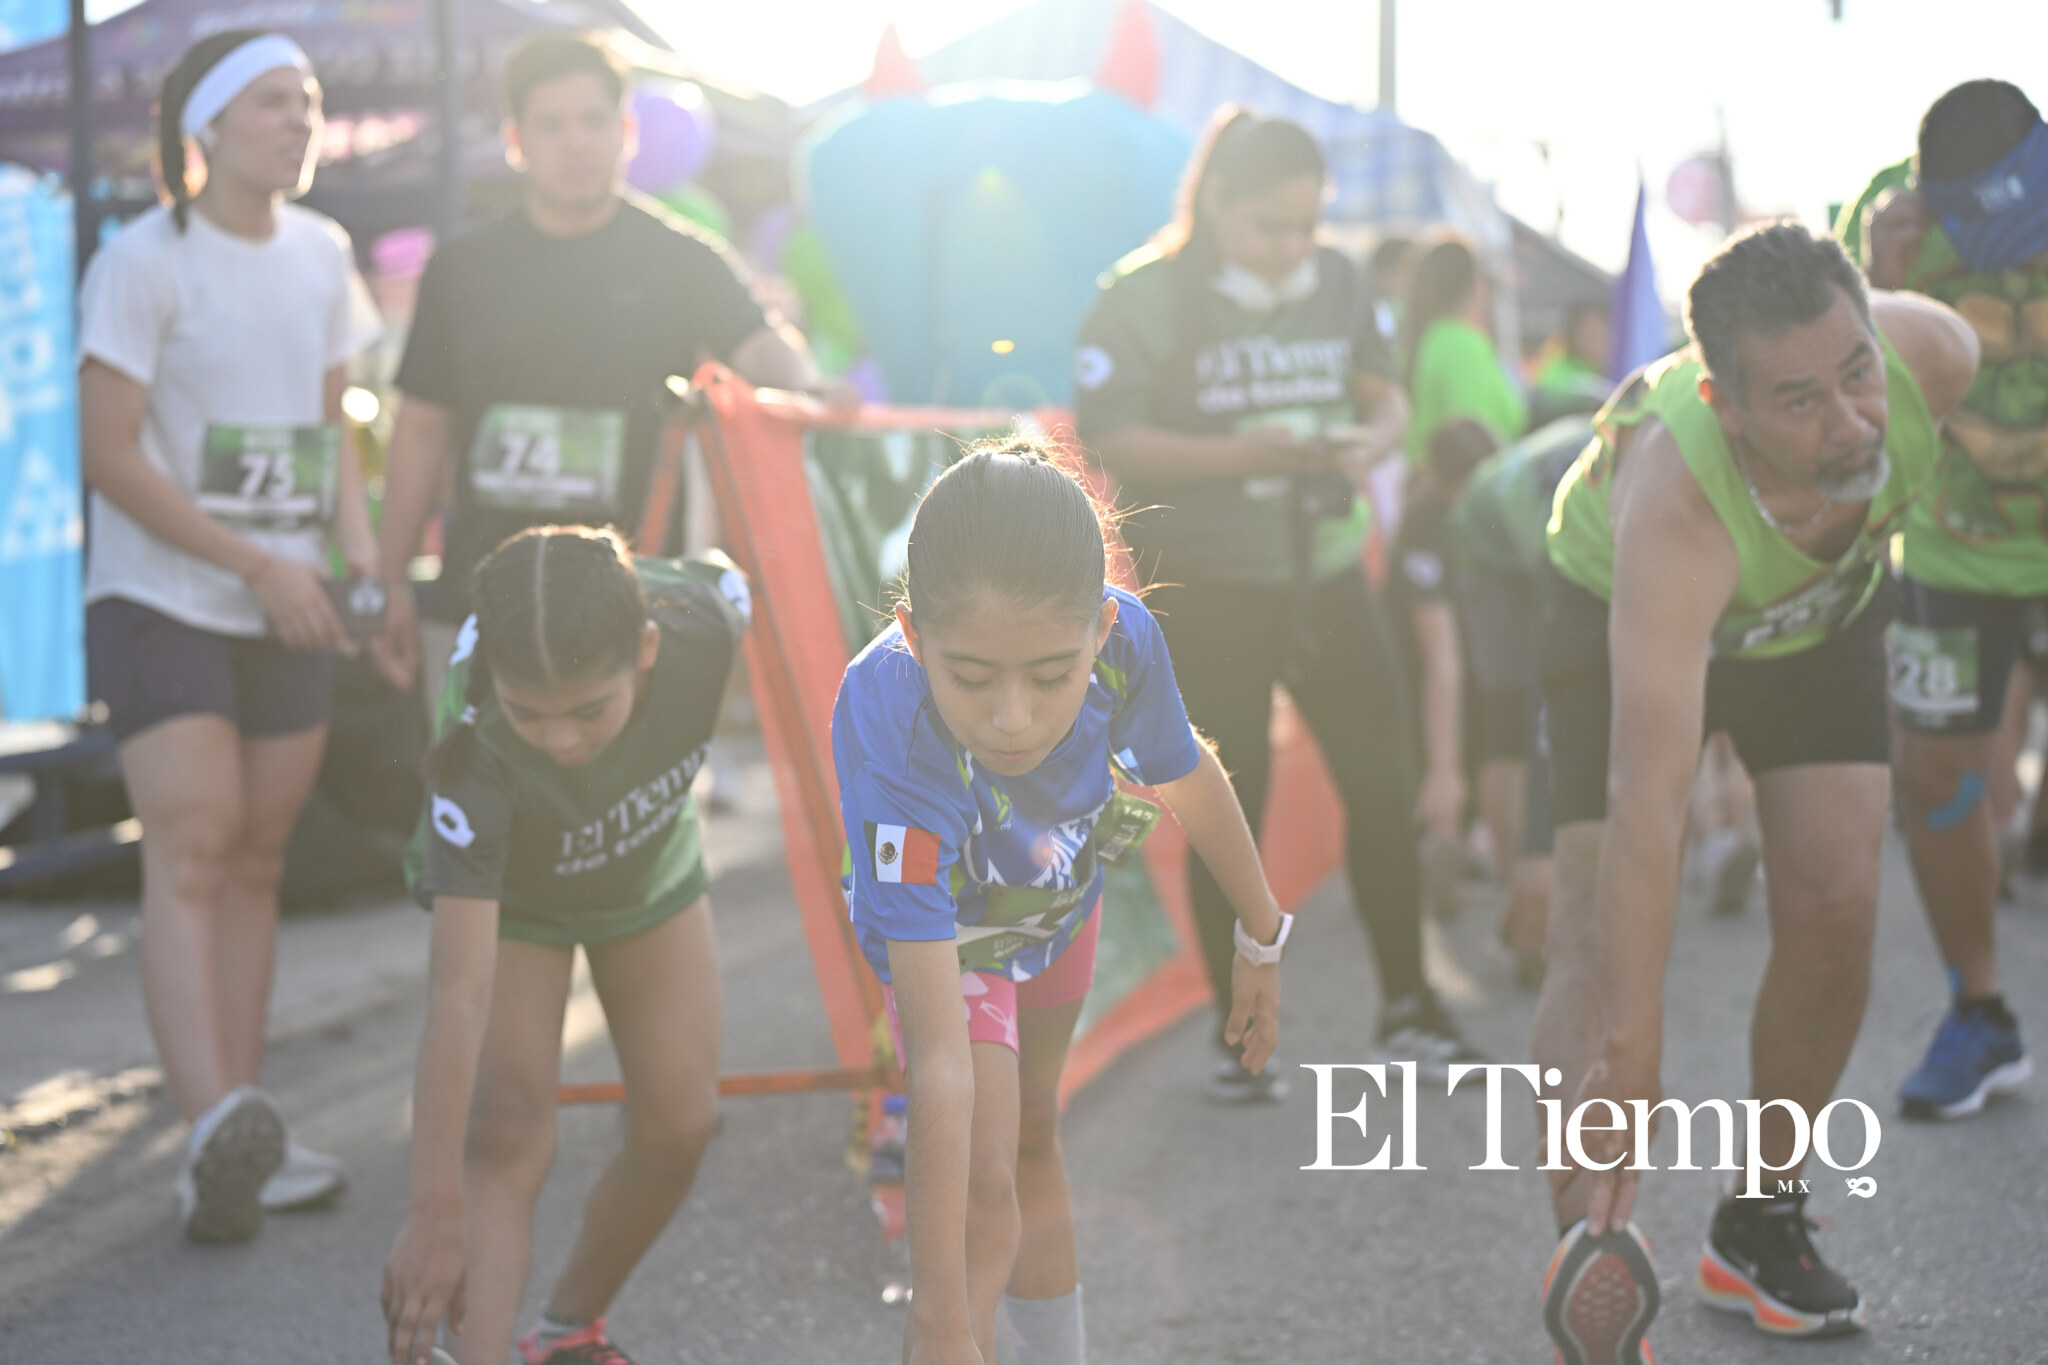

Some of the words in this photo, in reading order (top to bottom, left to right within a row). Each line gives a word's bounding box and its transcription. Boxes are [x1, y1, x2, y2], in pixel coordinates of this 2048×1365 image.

[238, 451, 296, 499] 75
[498, 431, 562, 478] 74
[1123, 804, 1154, 821] 145
[561, 818, 605, 858] El
